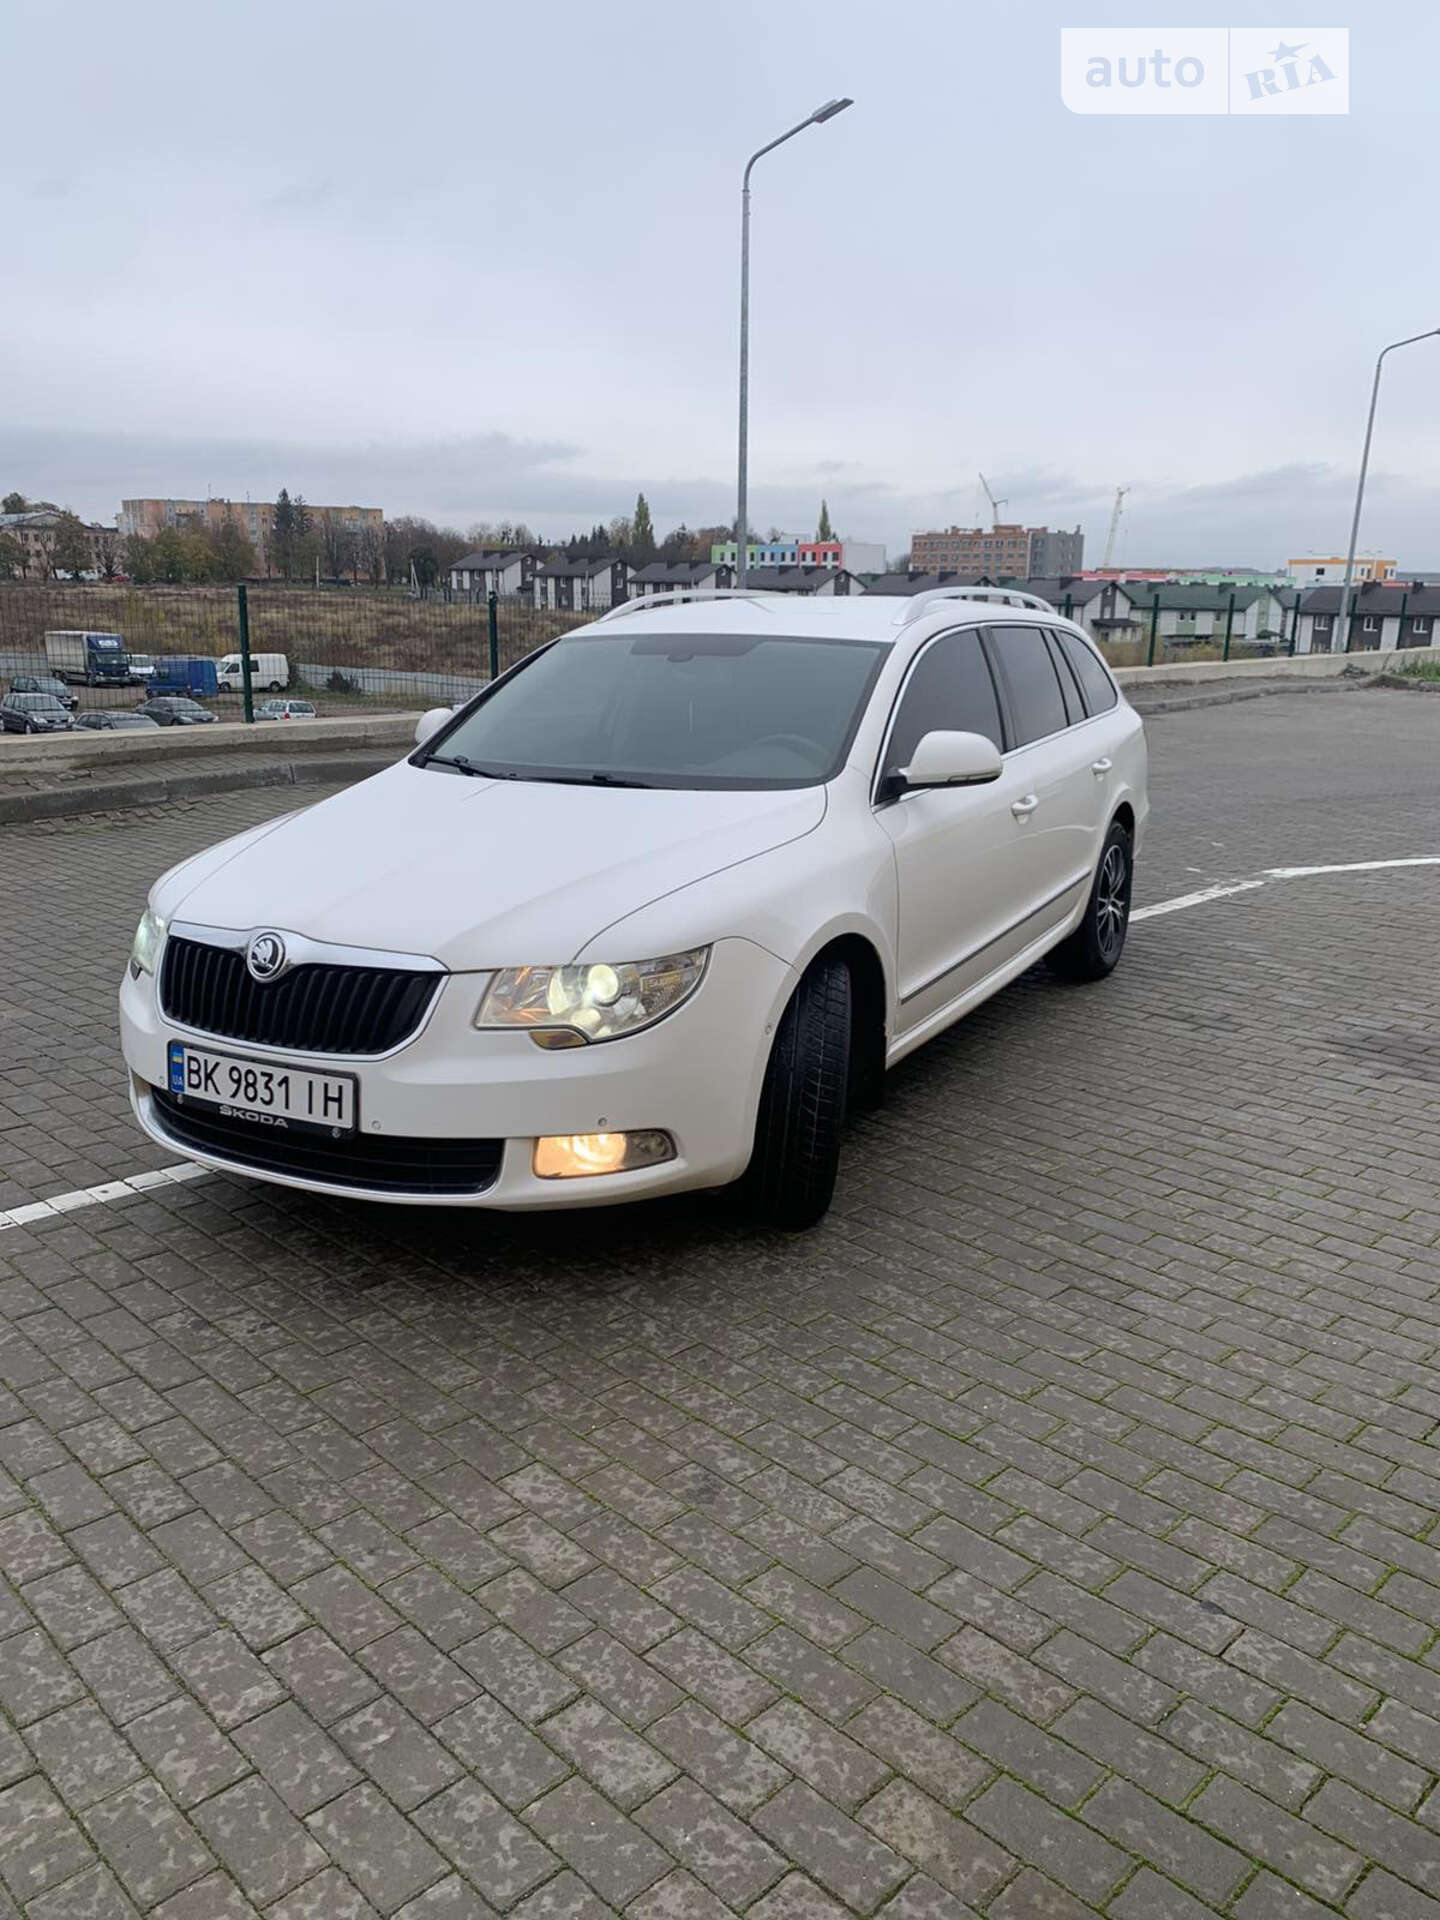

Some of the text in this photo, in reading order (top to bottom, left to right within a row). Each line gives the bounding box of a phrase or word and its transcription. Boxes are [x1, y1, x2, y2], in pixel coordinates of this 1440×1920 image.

[187, 1055, 344, 1120] BK 9831 IH
